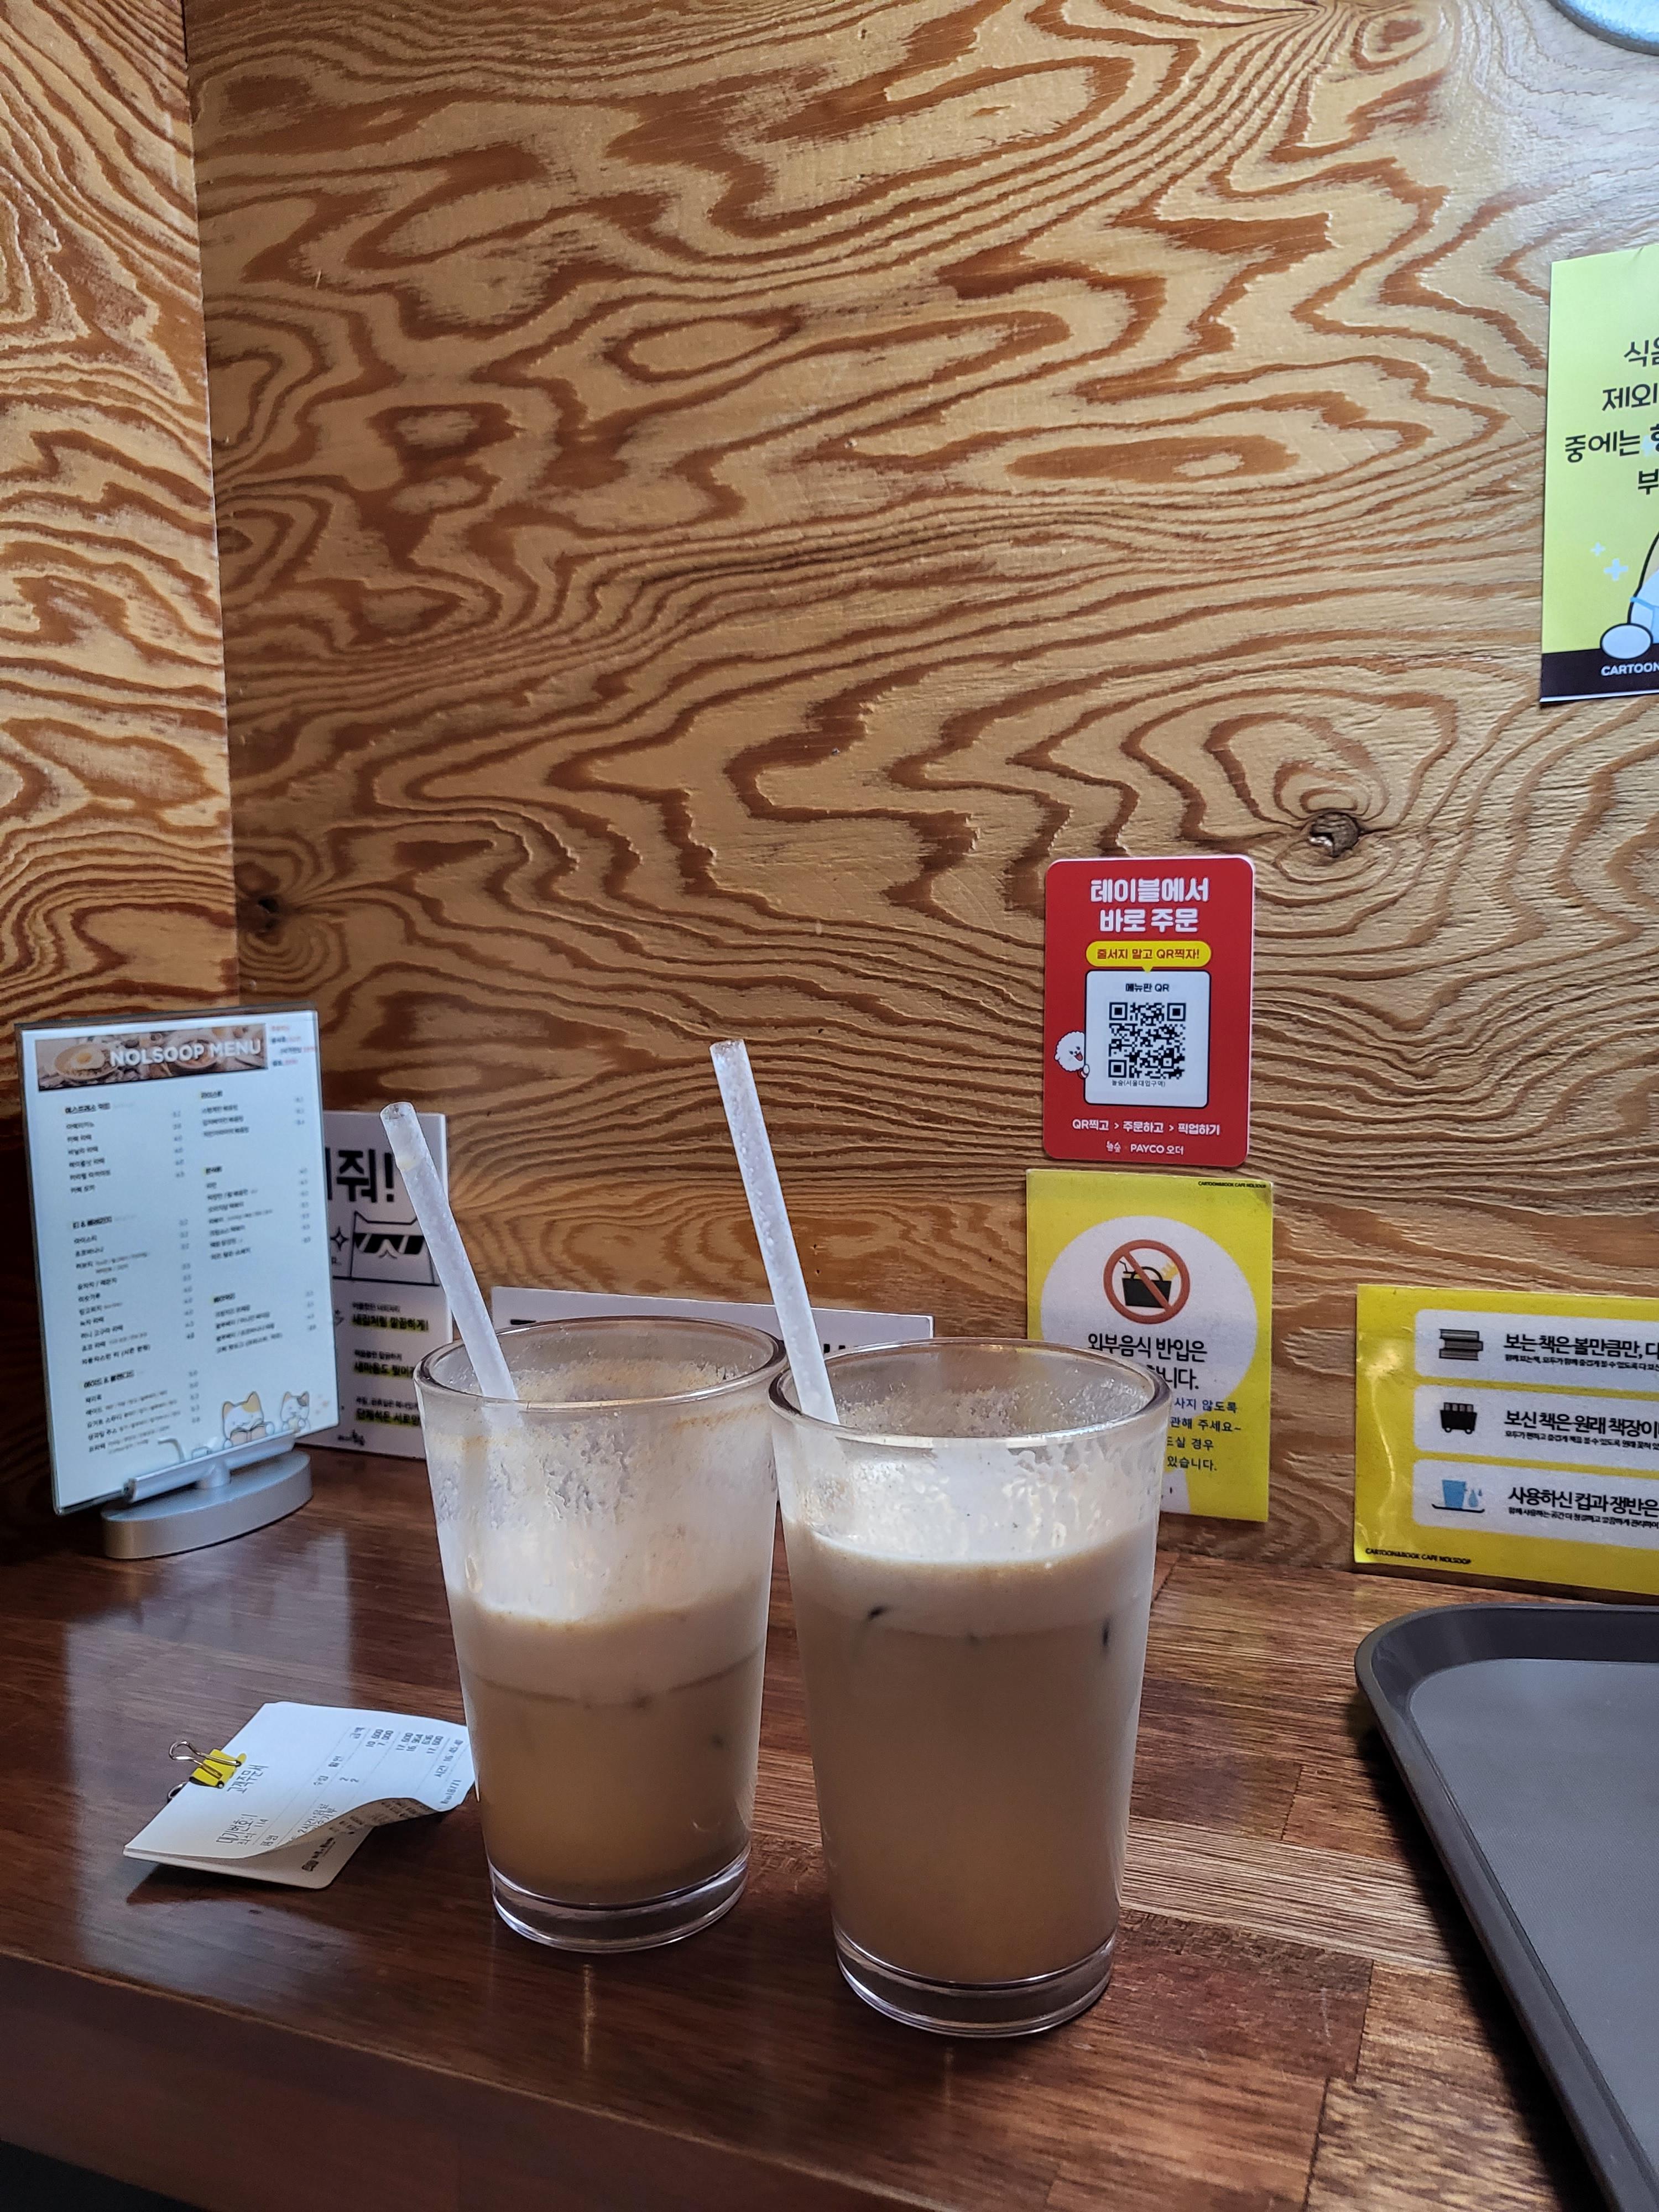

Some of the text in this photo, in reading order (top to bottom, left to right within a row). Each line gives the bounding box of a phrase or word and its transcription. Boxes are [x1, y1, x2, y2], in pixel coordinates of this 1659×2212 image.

[1565, 430, 1640, 463] 중에는
[1090, 877, 1209, 902] 테이블에서
[1100, 907, 1199, 933] 바로 주문
[1097, 948, 1199, 959] 줄서지 말고 QR찍자!
[1125, 983, 1152, 992] 메뉴판
[111, 1039, 262, 1067] NOLSOOP MENU
[1072, 1119, 1220, 1136] QR찍고 주문하고 픽업하기
[1130, 1144, 1164, 1154] PAYCO
[1166, 1145, 1184, 1155] 오더
[325, 1147, 394, 1203] 줘!
[1088, 1333, 1208, 1363] 외부음식 반입은
[1503, 1334, 1536, 1352] 보는
[1538, 1334, 1570, 1354] 책은
[1574, 1337, 1644, 1359] 볼만큼만,
[1202, 1399, 1238, 1413] 않도록
[1197, 1419, 1241, 1432] 주세요~
[1504, 1410, 1536, 1428] 보신
[1539, 1412, 1571, 1431] 책은
[1574, 1415, 1606, 1434] 원래
[1191, 1438, 1214, 1451] 경우
[1167, 1455, 1217, 1471] 있습니다.
[1508, 1486, 1659, 1518] 사용하신 컵과 쟁반은
[227, 1764, 269, 1794] 고객주문서
